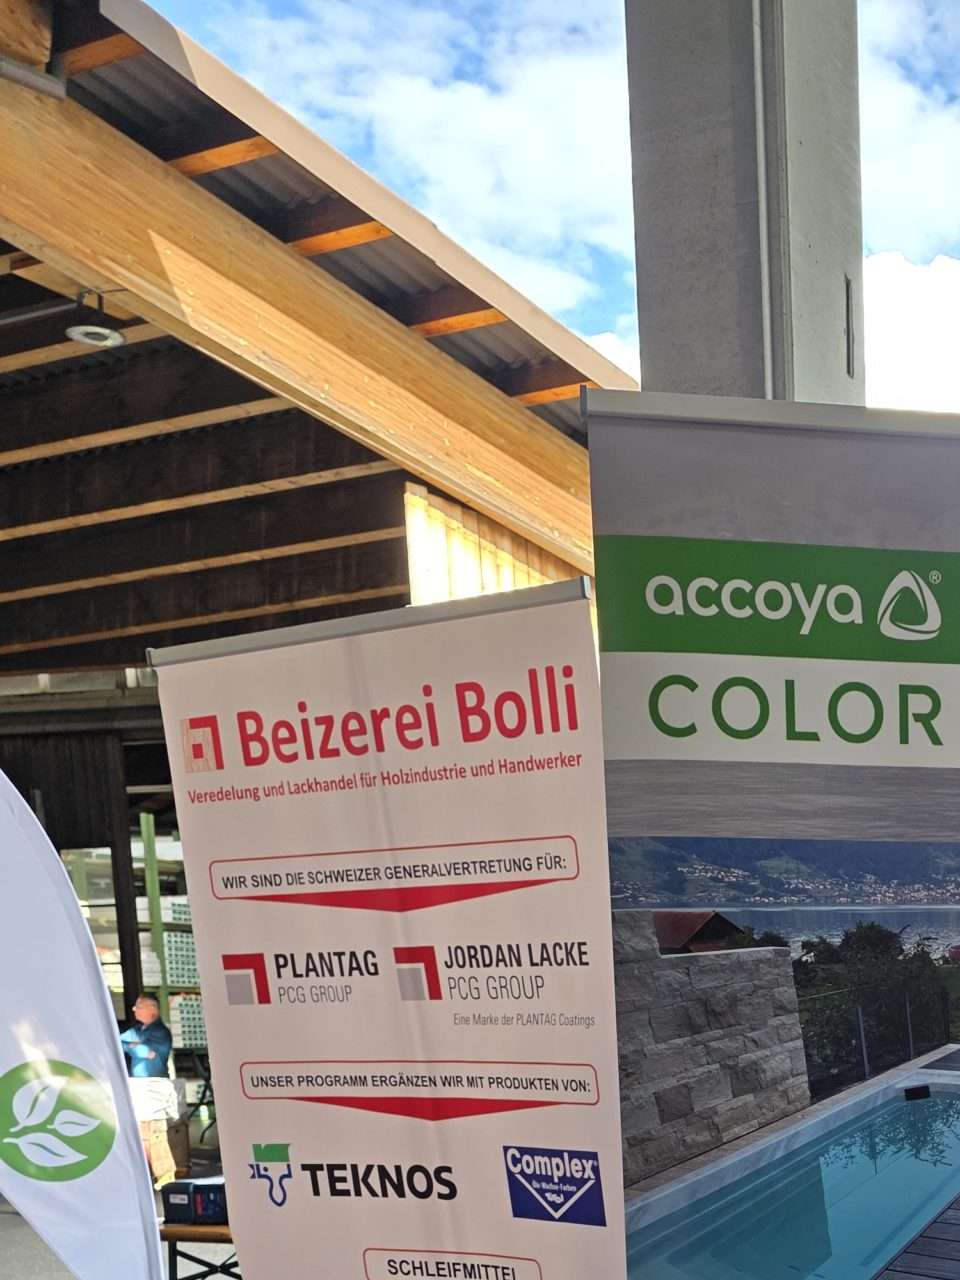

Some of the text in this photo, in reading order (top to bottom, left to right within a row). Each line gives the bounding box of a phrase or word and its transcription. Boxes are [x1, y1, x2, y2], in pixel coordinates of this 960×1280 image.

[645, 574, 863, 634] accoya
[236, 665, 579, 767] Beizerei Bolli
[648, 674, 945, 746] COLOR
[188, 752, 582, 804] Veredelung und Lackhandel für Holzindustrie und Handwerker
[222, 852, 567, 889] WIR SIND DIE SCHWEIZER GENERALVERTRETUNG FÜR:
[274, 941, 589, 979] PLANTAG JORDAN LACKE
[277, 984, 352, 1004] PCG GROUP
[448, 975, 545, 1000] PCG GROUP
[453, 1013, 595, 1029] Eine Marke der PLANTAG Coatings
[251, 1072, 591, 1092] UNSER PROGRAMM ERGÄNZEN WIR MIT PRODUKTEN VON:
[301, 1163, 458, 1201] TEKNOS
[506, 1148, 596, 1183] Complex
